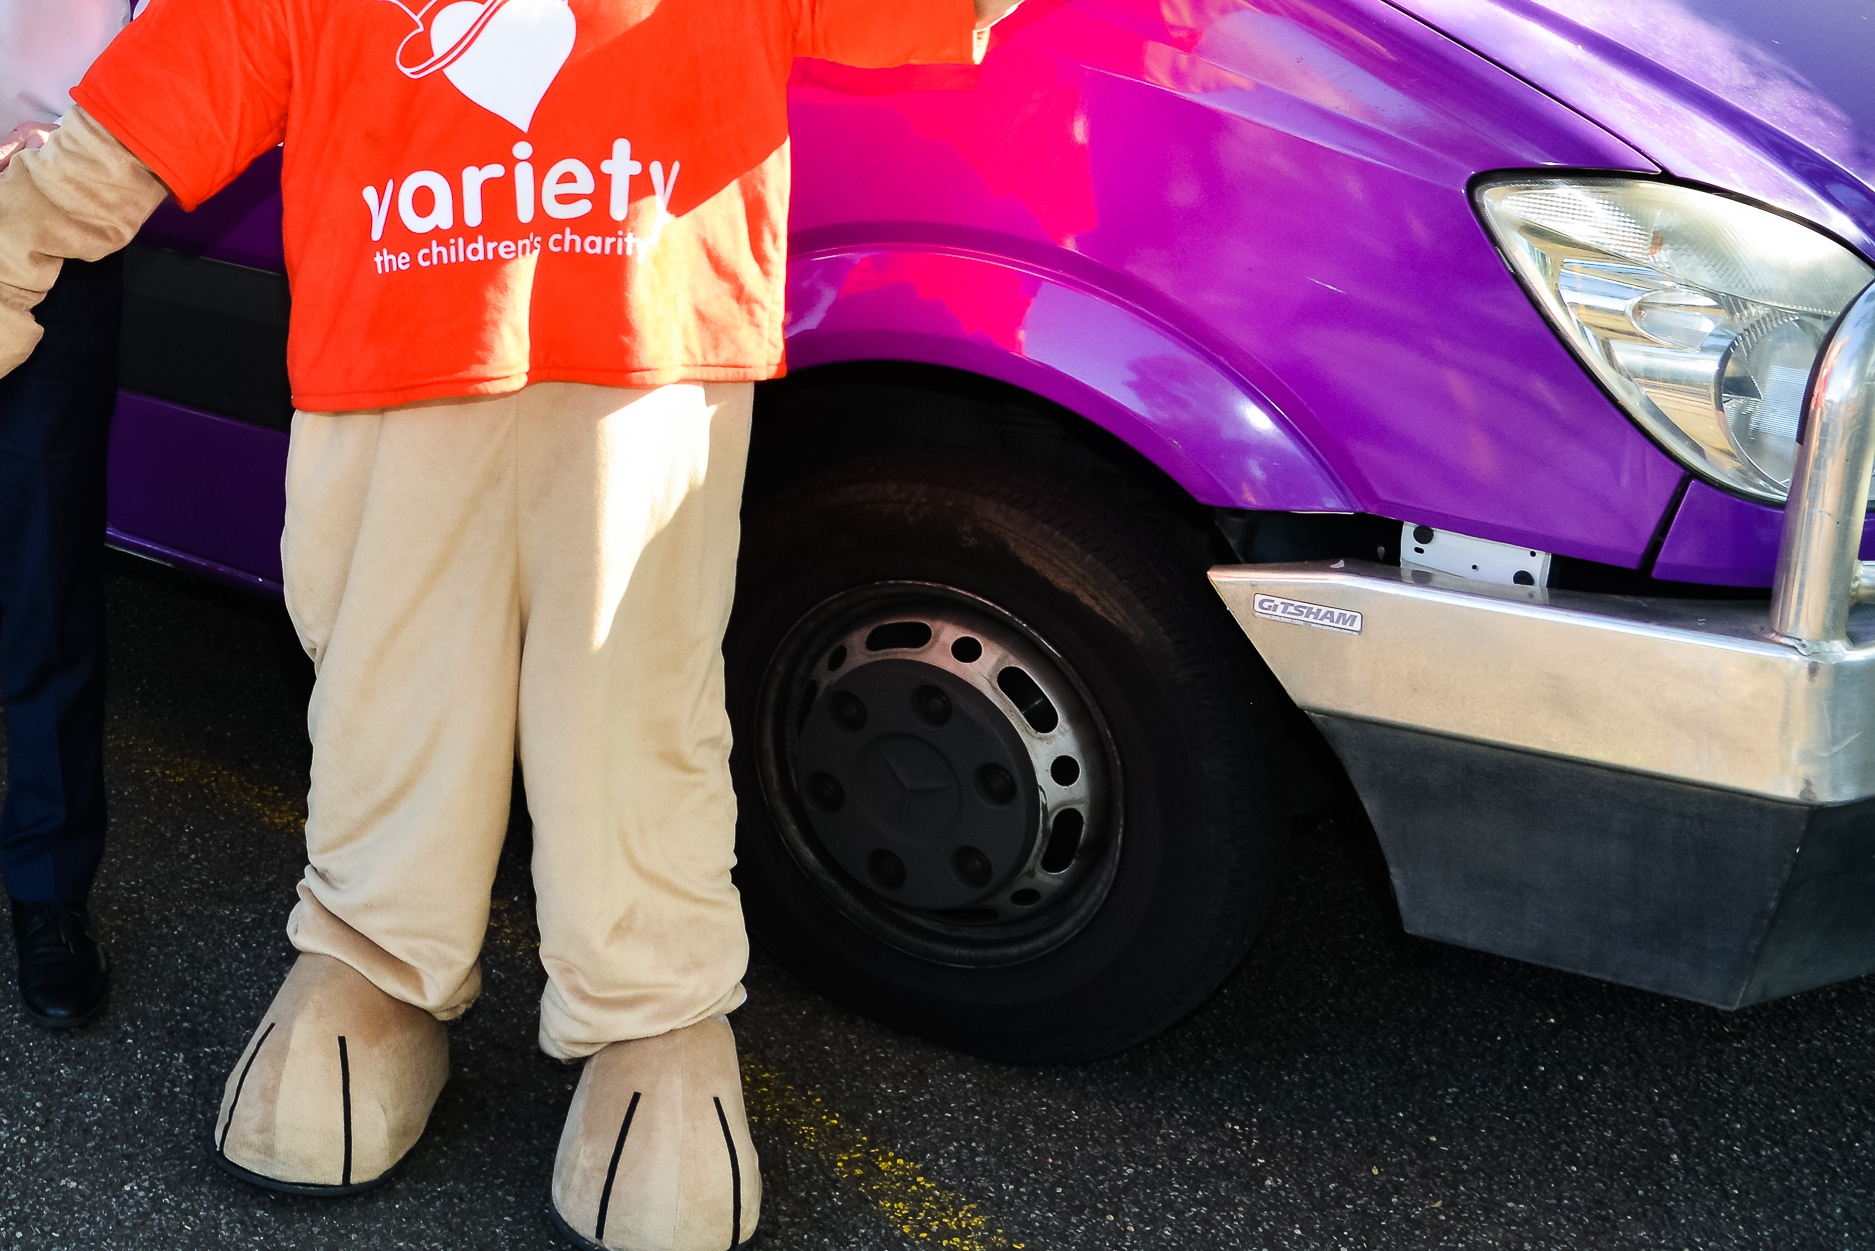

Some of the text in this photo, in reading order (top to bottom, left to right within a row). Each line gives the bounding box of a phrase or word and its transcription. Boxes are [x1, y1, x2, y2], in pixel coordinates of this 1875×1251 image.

[361, 137, 681, 246] variety
[374, 226, 651, 275] the children's charity
